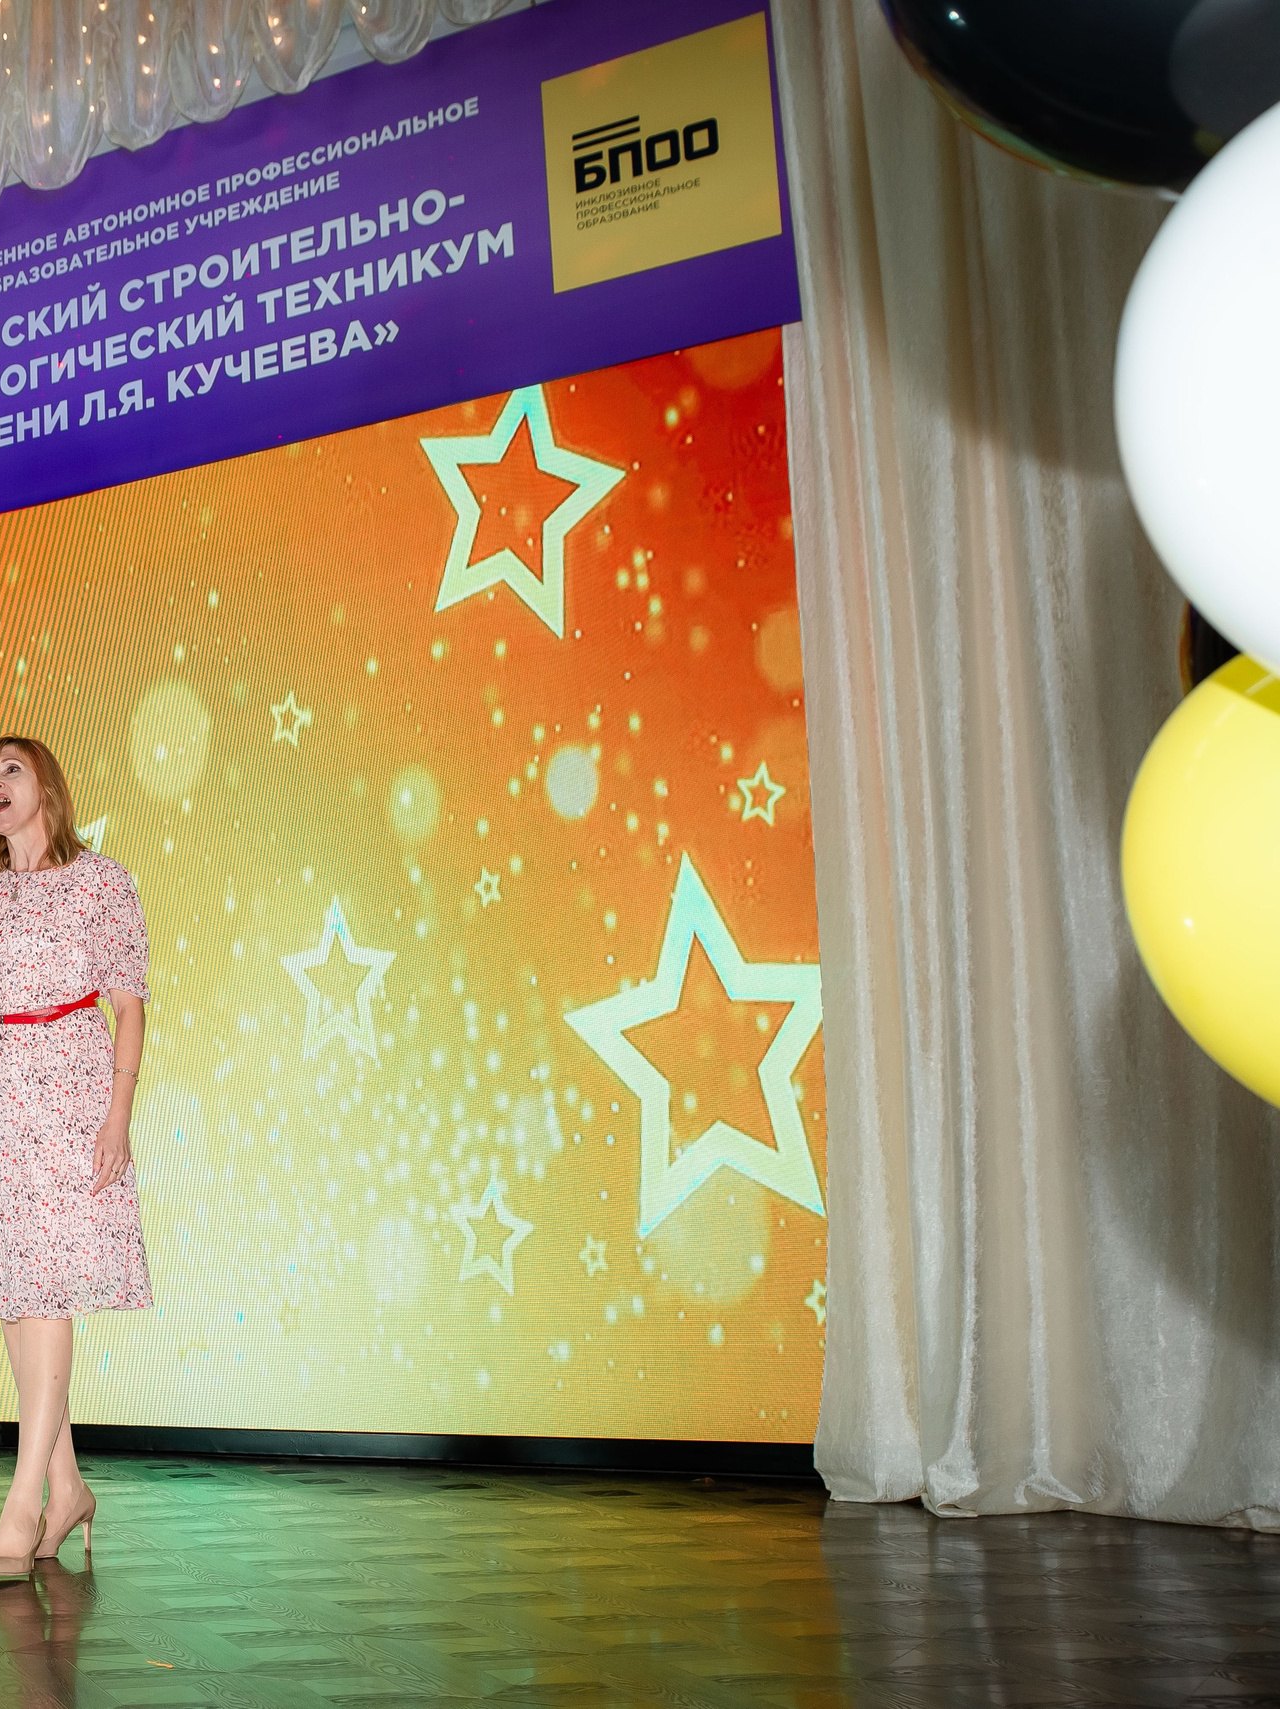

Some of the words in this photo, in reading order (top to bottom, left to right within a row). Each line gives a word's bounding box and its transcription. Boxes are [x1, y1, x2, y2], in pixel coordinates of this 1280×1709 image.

[62, 182, 210, 246] АВТОНОМНОЕ
[216, 96, 479, 197] ПРОФЕССИОНАЛЬНОЕ
[574, 117, 719, 194] БПОО
[575, 178, 661, 209] ИНКЛЮЗИВНОЕ
[184, 171, 340, 235] УЧРЕЖДЕНИЕ
[576, 178, 701, 221] ПРОФЕССИОНАЛЬНОЕ
[576, 200, 660, 231] ОБРАЗОВАНИЕ
[119, 189, 466, 312] СТРОИТЕЛЬНО-
[256, 222, 515, 325] ТЕХНИКУМ
[79, 378, 155, 427] Л.Я.
[167, 319, 400, 402] КУЧЕЕВА»
